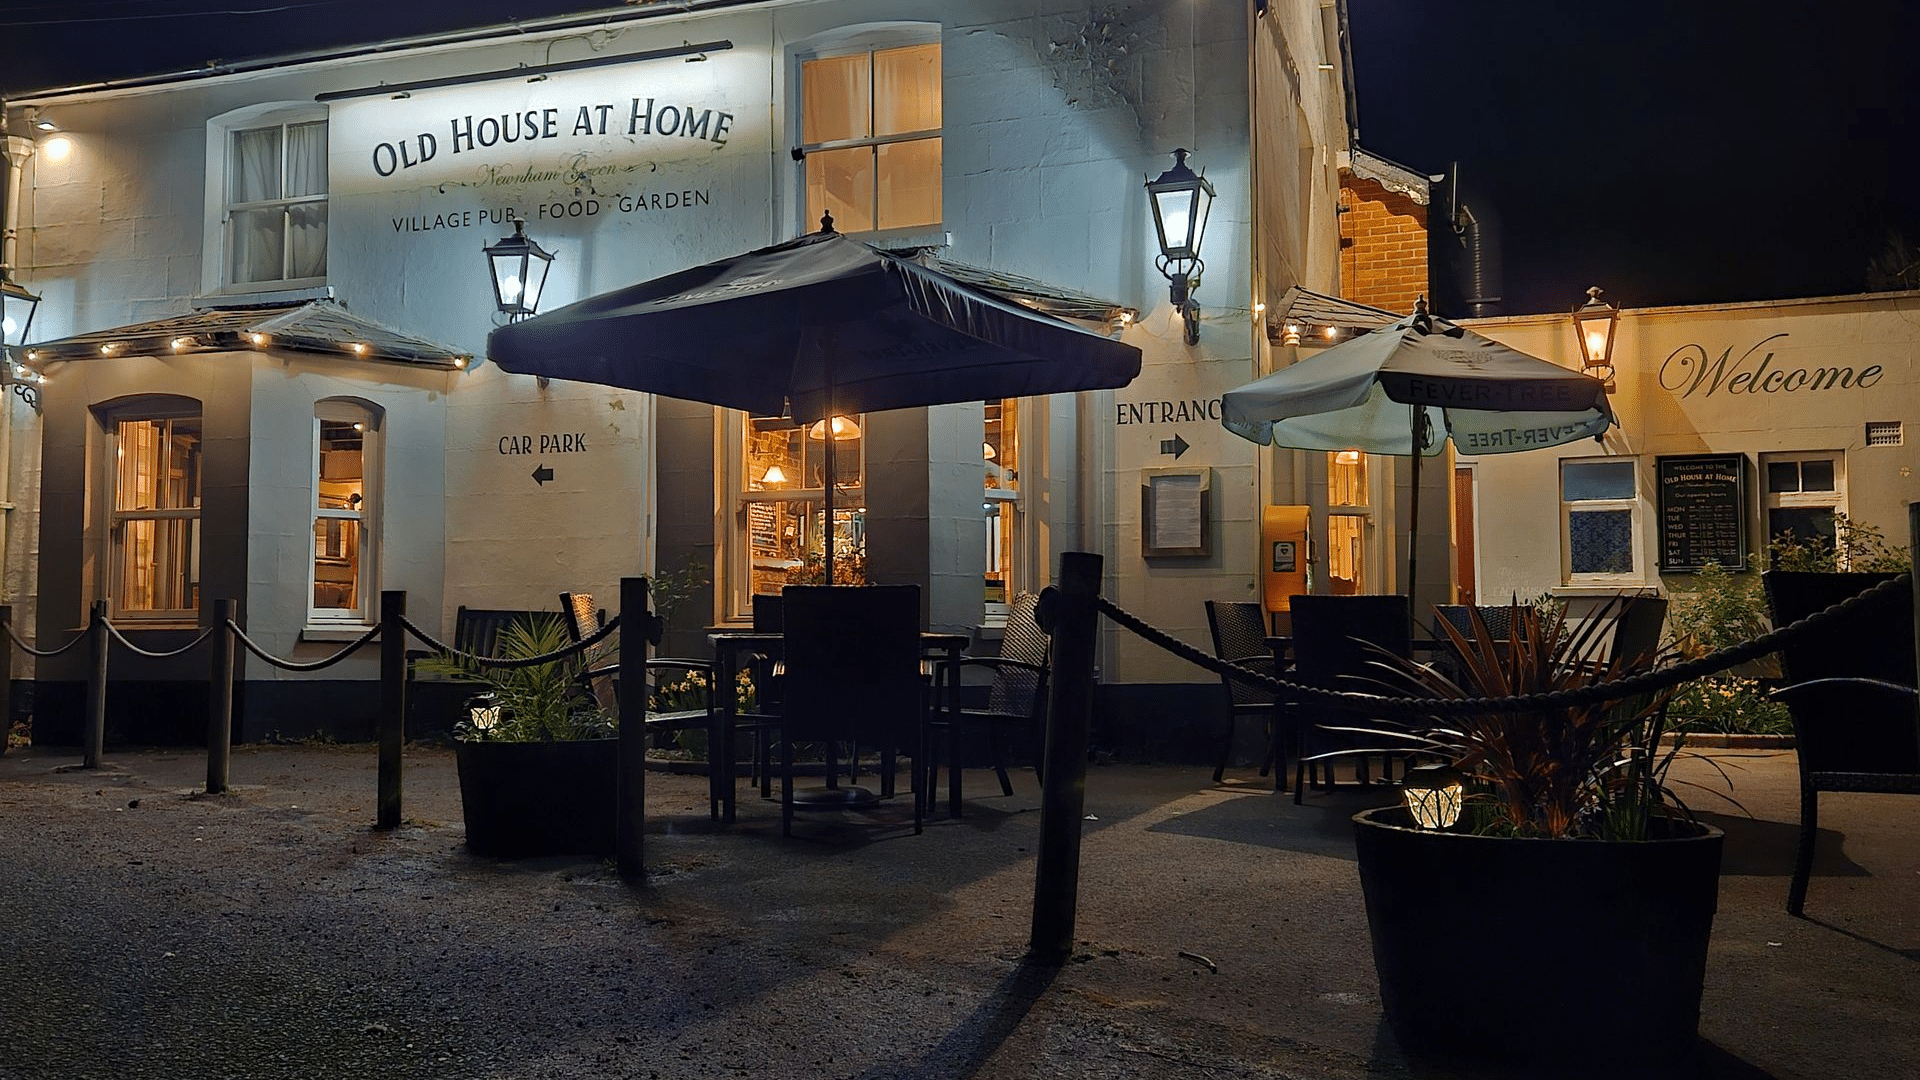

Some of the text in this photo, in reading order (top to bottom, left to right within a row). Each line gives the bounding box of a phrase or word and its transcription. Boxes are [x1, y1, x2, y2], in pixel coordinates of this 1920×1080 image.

[372, 98, 734, 178] OLD HOUSE AT HOME
[472, 163, 560, 188] Newnham
[392, 190, 711, 234] VILLAGE PUB FOOD GARDEN
[1659, 333, 1884, 400] Welcome
[1409, 379, 1571, 402] FEVER-TREE
[1116, 399, 1221, 425] ENTRANC
[498, 432, 587, 455] CAR PARK
[1664, 476, 1679, 485] OLD
[1680, 474, 1703, 482] HOUSE
[1715, 473, 1737, 483] HOME
